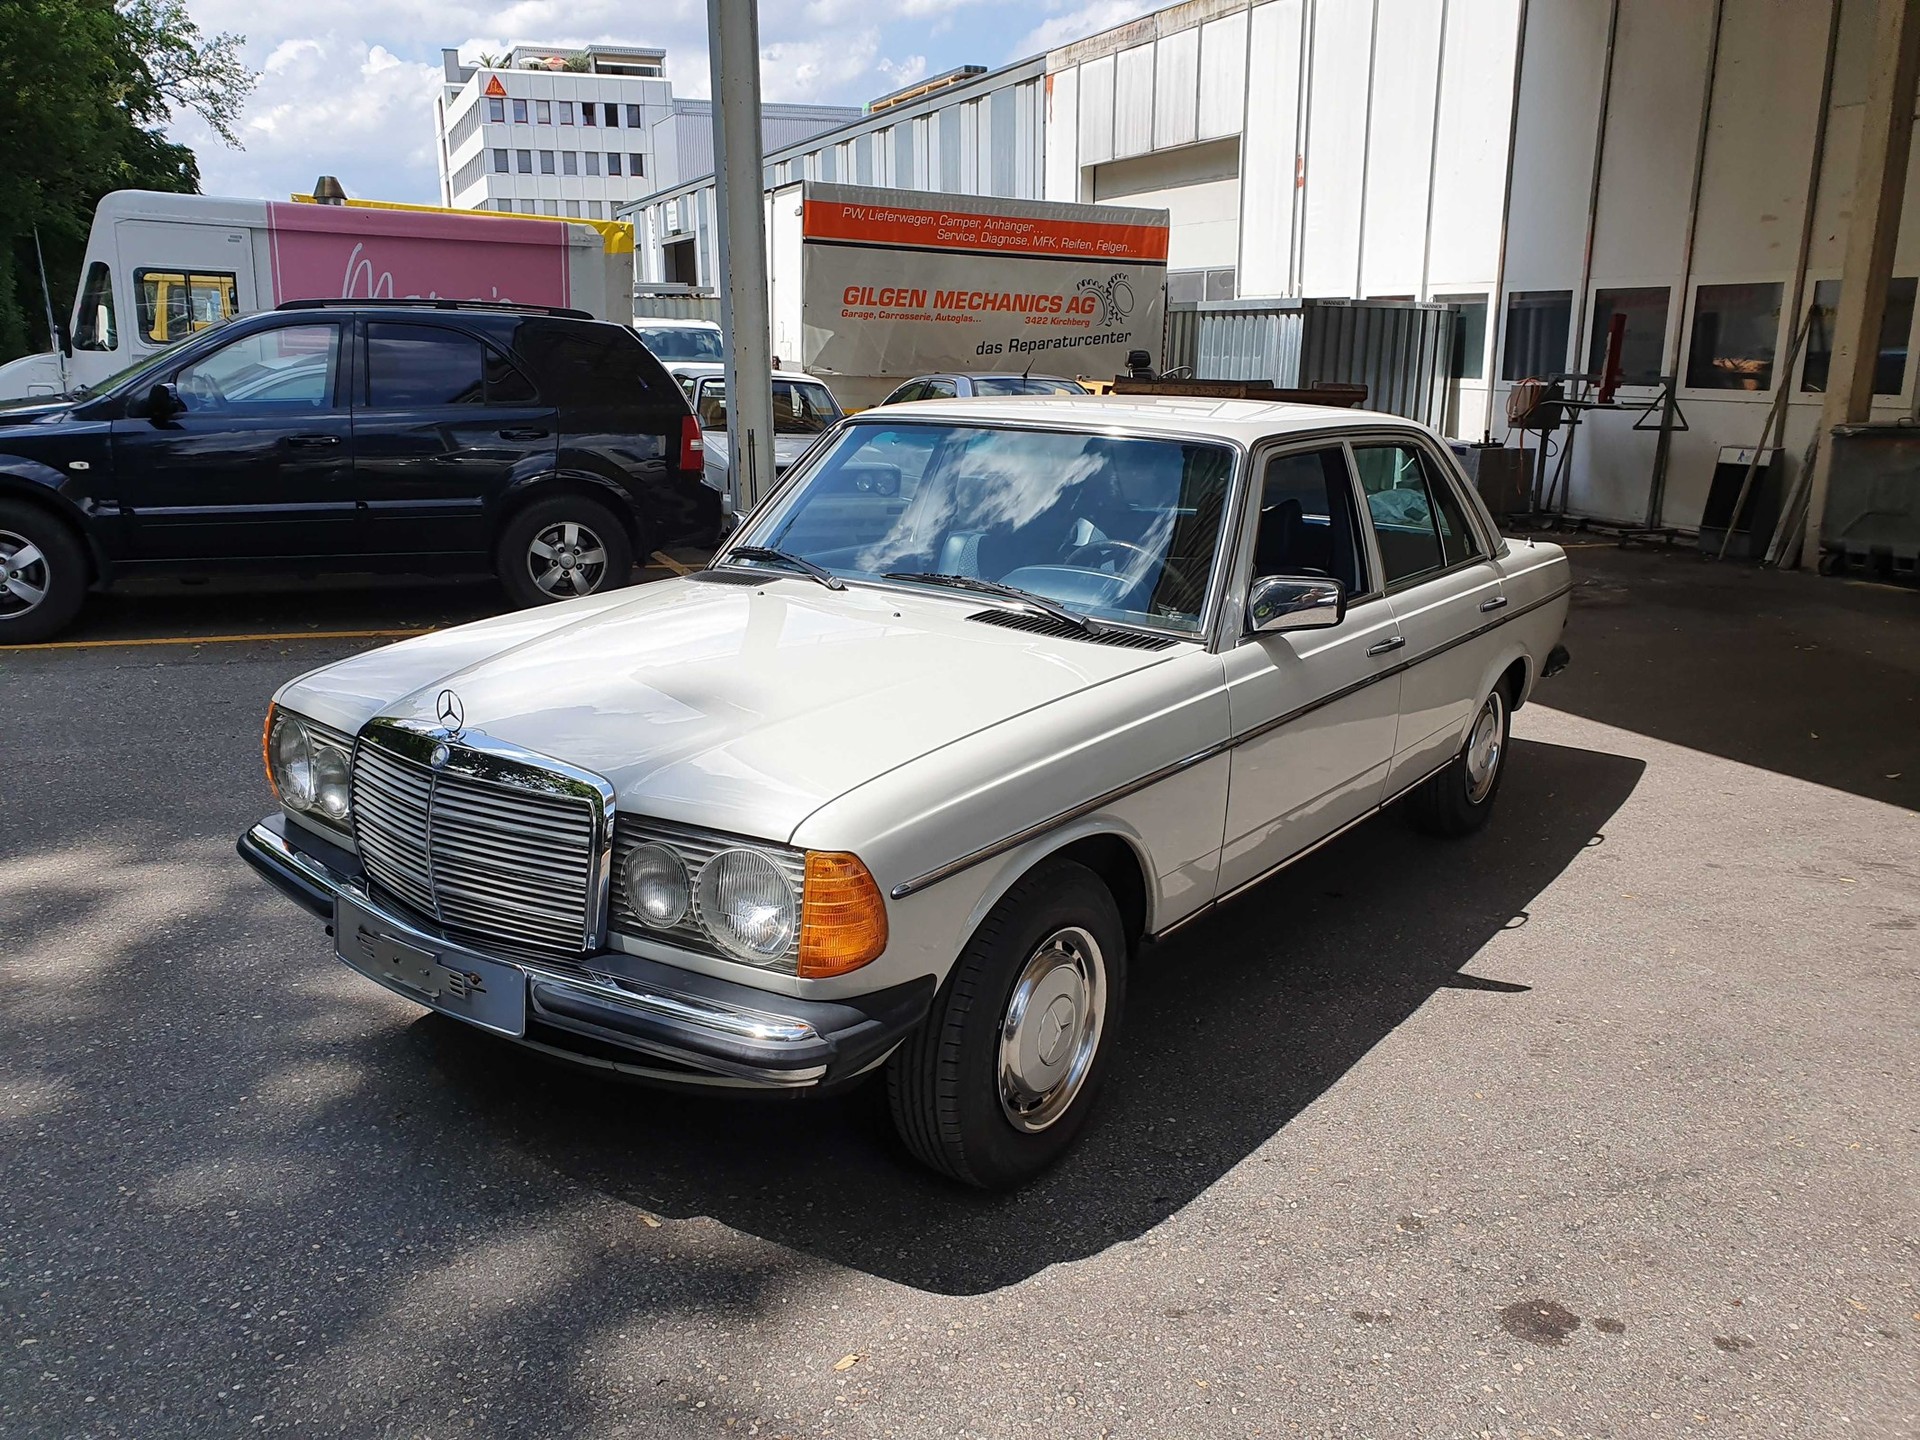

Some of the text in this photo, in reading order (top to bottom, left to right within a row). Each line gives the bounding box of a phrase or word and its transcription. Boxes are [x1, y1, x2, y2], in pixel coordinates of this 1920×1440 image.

[842, 206, 865, 221] PW,
[868, 209, 937, 227] Lieferwagen,
[939, 215, 982, 229] Camper,
[937, 228, 1137, 254] Service, Diagnose, MFK, Reifen, Felgen...
[843, 286, 1096, 314] GILGEN MECHANICS AG
[841, 309, 982, 324] Garage, Carrosserie, Autoglas...
[1025, 316, 1090, 328] 3422 Kirchberg
[976, 331, 1132, 355] das Reparaturcenter
